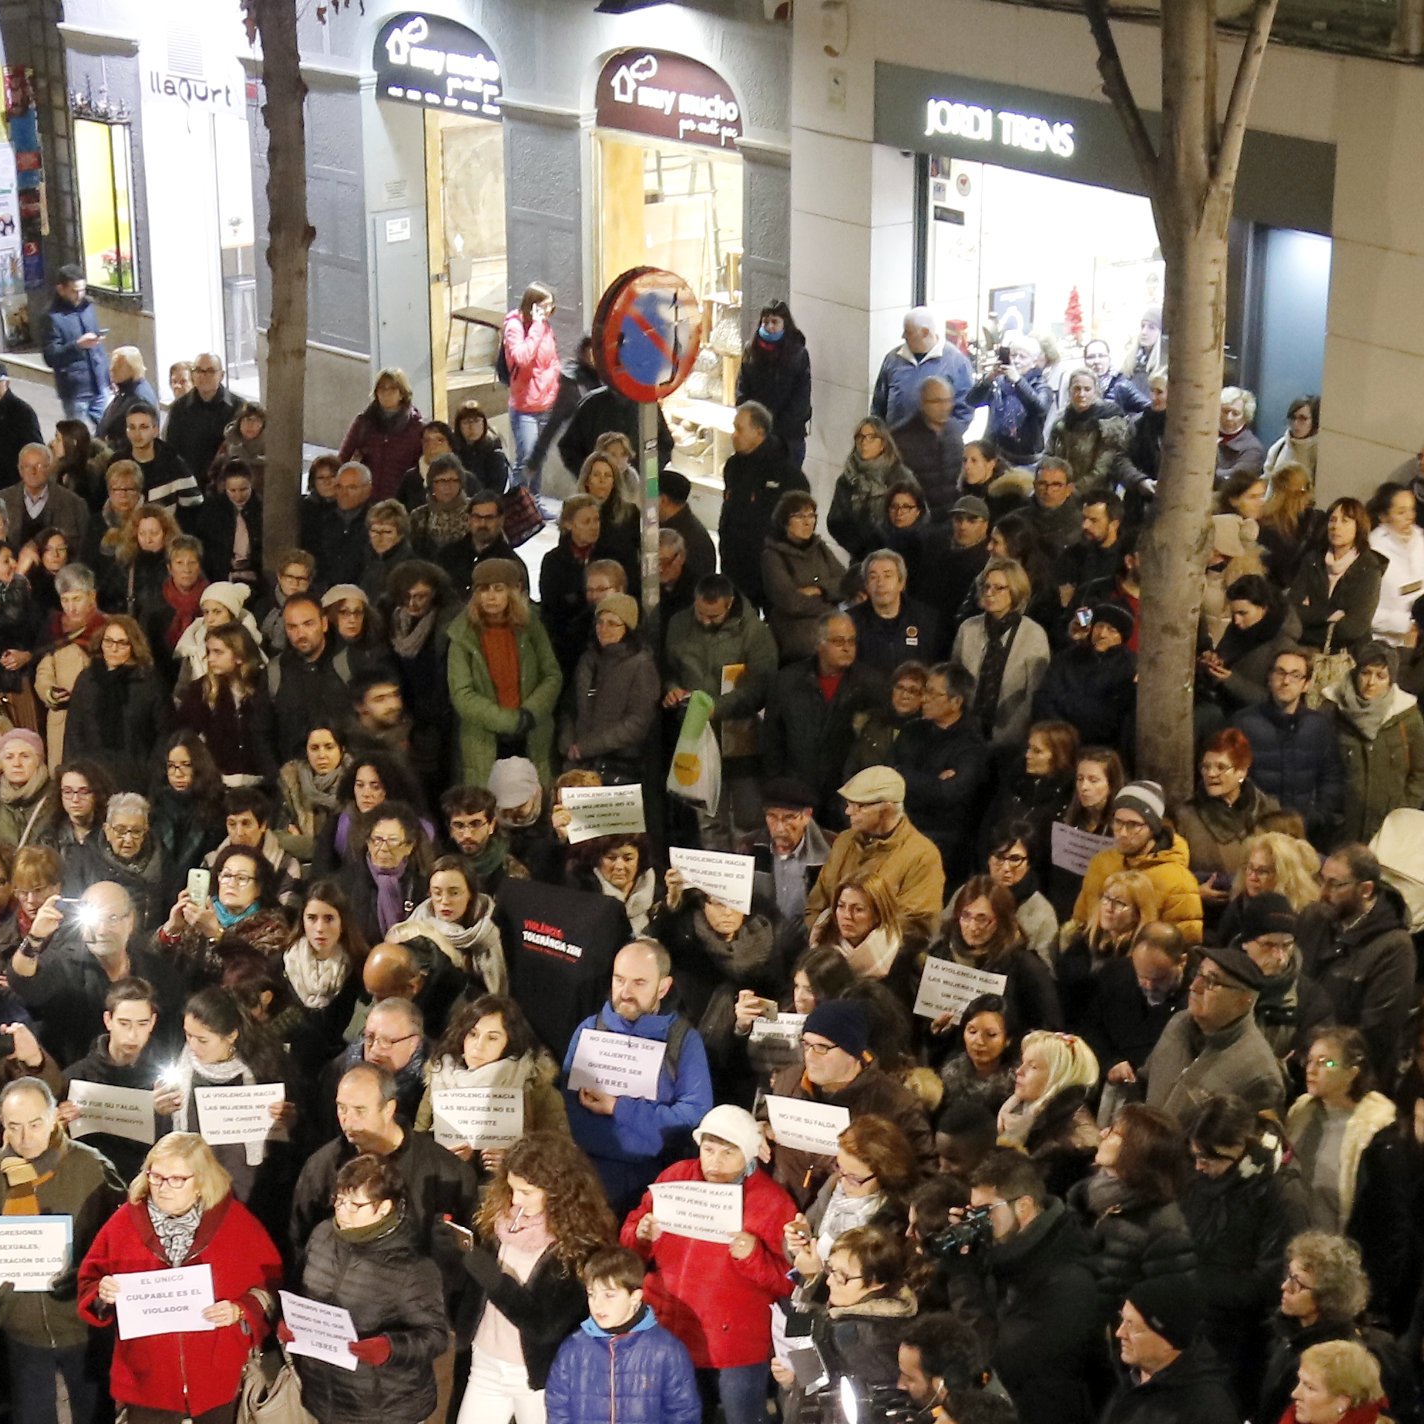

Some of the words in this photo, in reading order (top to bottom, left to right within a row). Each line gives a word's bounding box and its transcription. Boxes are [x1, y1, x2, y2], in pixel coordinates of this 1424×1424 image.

[408, 46, 446, 76] muy
[446, 52, 502, 82] mucho
[636, 84, 676, 116] muy
[678, 92, 740, 122] mucho
[924, 98, 992, 142] JORDI
[996, 110, 1074, 158] TRENS
[684, 856, 724, 864] VIOLENCIA
[688, 868, 722, 880] MUJERES
[724, 872, 734, 880] NO
[736, 872, 746, 880] ES
[940, 966, 978, 980] VIOLENCIA
[978, 976, 1000, 986] HACIA
[600, 1036, 640, 1050] QUEREMOS
[640, 1042, 656, 1052] SER
[598, 1050, 638, 1062] VALIENTES,
[586, 1062, 628, 1074] QUEREMOS
[628, 1068, 644, 1076] SER
[596, 1076, 630, 1090] LIBRES
[450, 1092, 490, 1100] VIOLENCIA
[492, 1092, 516, 1100] HACIA
[88, 1100, 102, 1108] FUE
[104, 1102, 114, 1110] SU
[456, 1104, 492, 1112] MUJERES
[492, 1106, 504, 1114] NO
[506, 1106, 516, 1114] ES
[788, 1114, 802, 1122] FUE
[802, 1116, 814, 1124] SU
[34, 1256, 46, 1264] DE
[46, 1256, 64, 1264] LOS
[140, 1278, 152, 1286] EL
[126, 1290, 174, 1302] CULPABLE
[176, 1290, 188, 1298] ES
[190, 1288, 202, 1296] EL
[142, 1304, 190, 1316] VIOLADOR
[310, 1340, 338, 1354] LIBRES
